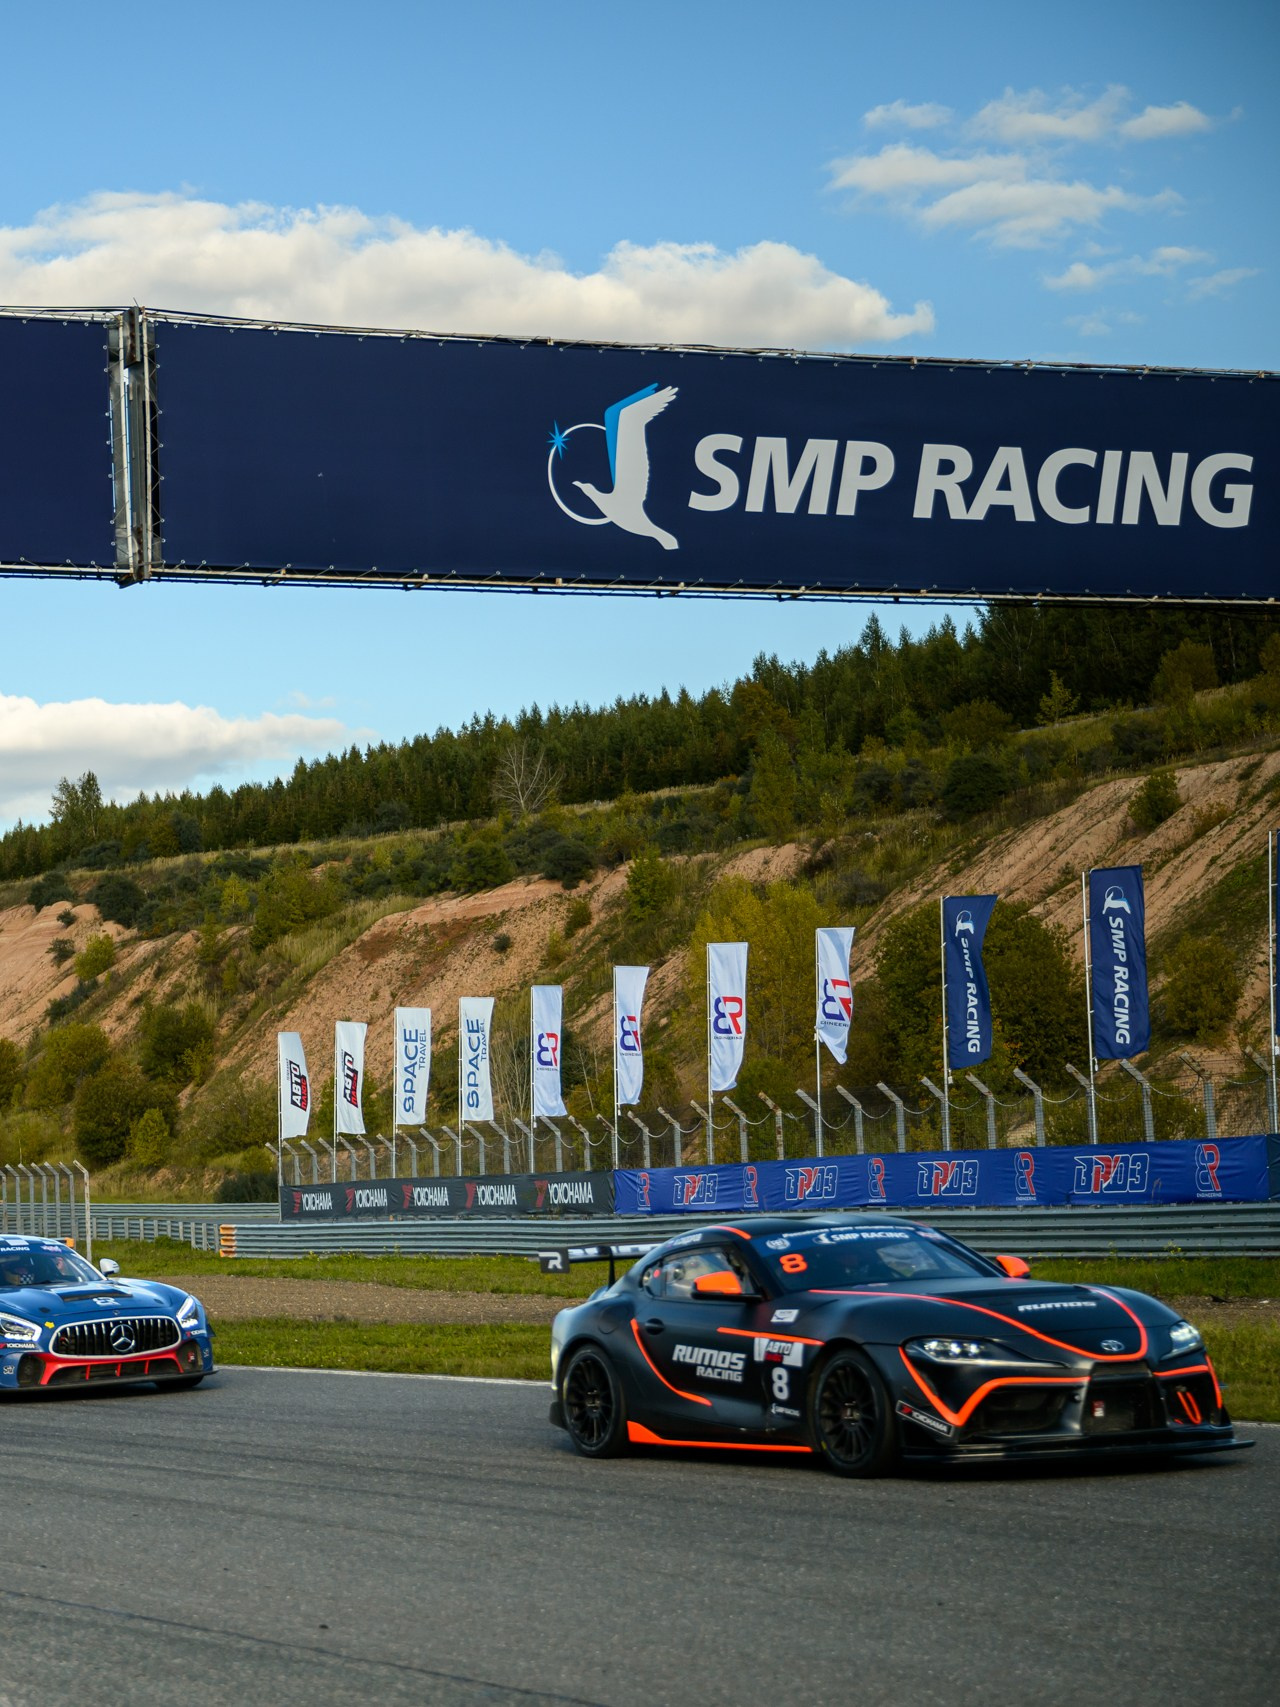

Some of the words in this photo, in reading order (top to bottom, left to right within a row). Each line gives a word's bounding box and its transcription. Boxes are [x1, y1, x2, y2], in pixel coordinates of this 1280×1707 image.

[688, 434, 895, 516] SMP
[913, 443, 1255, 528] RACING
[1108, 916, 1128, 963] SMP
[960, 937, 974, 979] SMP
[966, 982, 981, 1053] RACING
[1113, 965, 1131, 1045] RACING
[418, 1029, 427, 1070] TRAVEL
[403, 1028, 419, 1113] SPACE
[467, 1018, 481, 1109] SPACE
[290, 1062, 302, 1107] АВТО
[1074, 1153, 1150, 1194] BR03
[302, 1191, 333, 1212] YOKOHAMA
[354, 1188, 388, 1209] YOKOHAMA
[412, 1186, 449, 1207] YOKOHAMA
[476, 1184, 517, 1205] YOKOHAMA
[548, 1180, 594, 1205] YOKOHAMA
[830, 1233, 859, 1241] SMP
[861, 1231, 910, 1240] RACING
[779, 1253, 808, 1274] 8
[1017, 1301, 1097, 1312] RUMOS
[671, 1344, 747, 1371] RUMOS
[766, 1341, 793, 1355] АВТО
[696, 1366, 743, 1383] RACING
[771, 1367, 790, 1400] 8
[911, 1410, 948, 1433] YOKOHAMA
